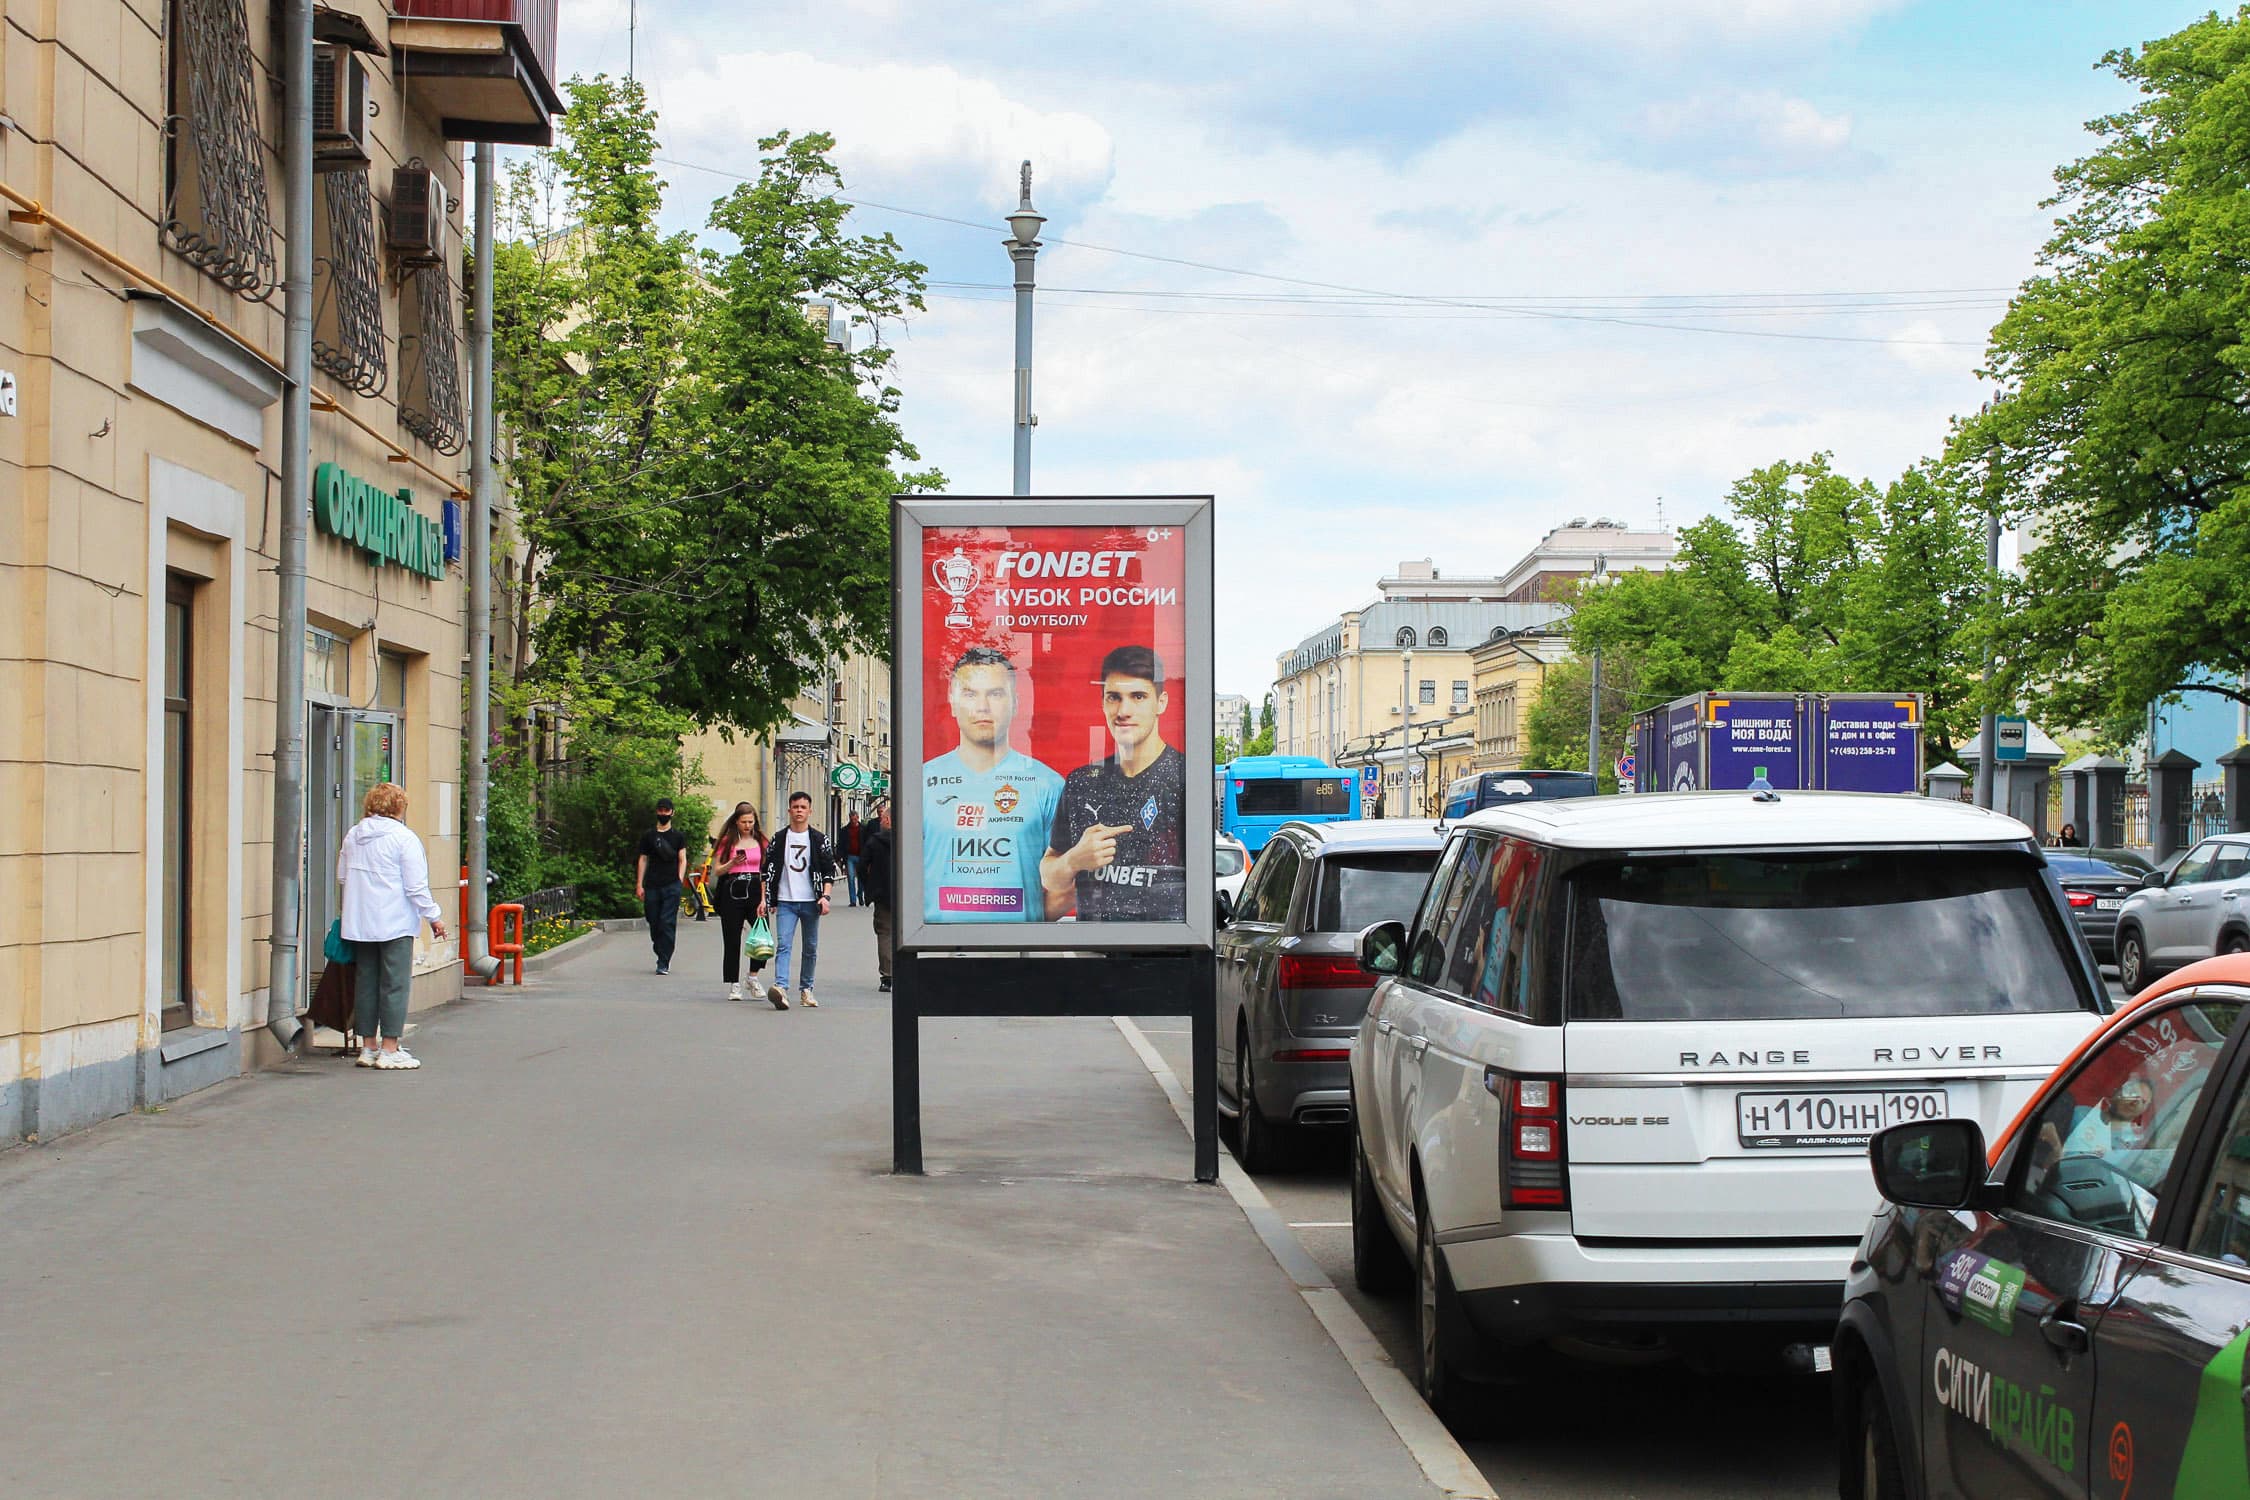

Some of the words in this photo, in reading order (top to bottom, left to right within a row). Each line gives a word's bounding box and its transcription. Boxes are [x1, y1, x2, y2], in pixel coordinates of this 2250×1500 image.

[316, 462, 418, 570] ОВОЩНОЙ
[1146, 527, 1172, 543] 6+
[995, 551, 1136, 579] FONBET
[995, 587, 1072, 607] КУБОК
[1080, 586, 1177, 606] РОССИИ
[995, 615, 1015, 626] ПО
[1018, 614, 1089, 627] ФУТБОЛУ
[1731, 718, 1772, 729] ШИШКИН
[1774, 719, 1792, 729] ЛЕС
[1830, 719, 1870, 731] Доставка
[1872, 721, 1896, 731] воды
[1731, 728, 1755, 740] МОЯ
[1758, 728, 1792, 742] ВОДА!
[1829, 731, 1840, 740] на
[1841, 731, 1857, 741] дом
[1859, 731, 1865, 740] и
[1867, 731, 1873, 740] в
[1874, 730, 1896, 741] офис
[940, 776, 963, 785] ПСБ
[957, 805, 985, 816] FON
[956, 816, 985, 827] BET
[957, 837, 1012, 857] ИКС
[957, 866, 1001, 875] ХОЛДИНГ
[1090, 864, 1158, 888] ONBET
[946, 893, 1017, 905] WILDBERRIES
[1680, 1049, 1811, 1067] RANGE
[1874, 1045, 2002, 1063] ROVER
[1569, 1115, 1639, 1126] VOGUE
[1642, 1115, 1670, 1126] SE
[1934, 1347, 2075, 1473] СИТИДРАЙВ
